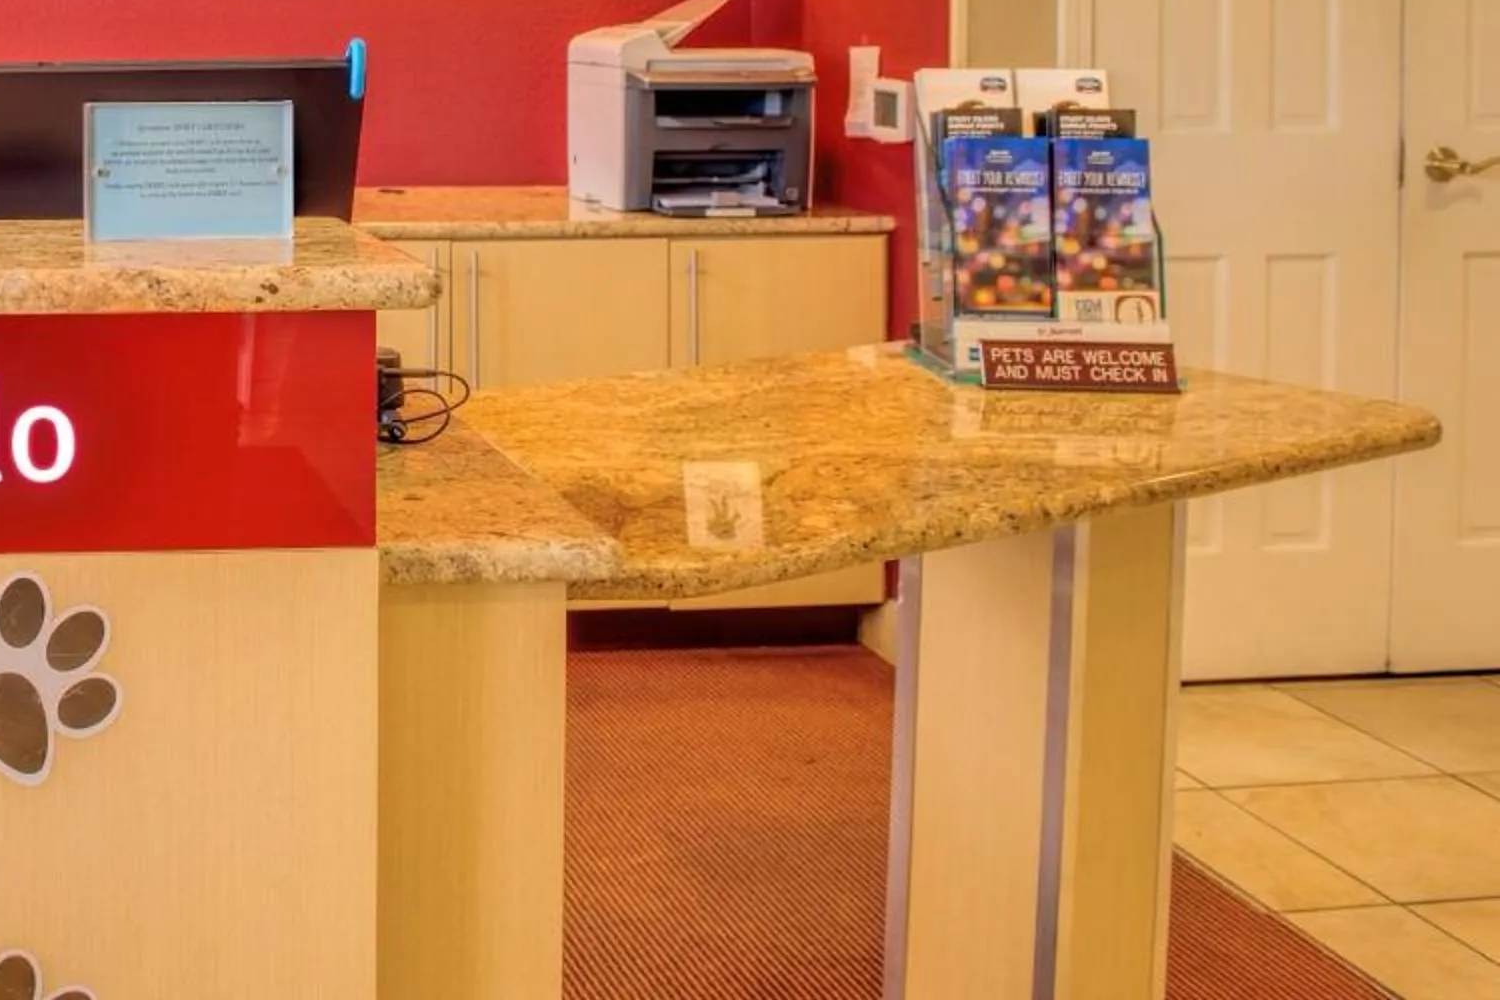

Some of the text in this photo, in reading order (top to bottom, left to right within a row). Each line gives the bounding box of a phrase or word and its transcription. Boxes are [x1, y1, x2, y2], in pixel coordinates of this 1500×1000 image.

[991, 348, 1166, 367] PETS ARE WELCOME
[995, 365, 1168, 383] AND MUST CHECK IN
